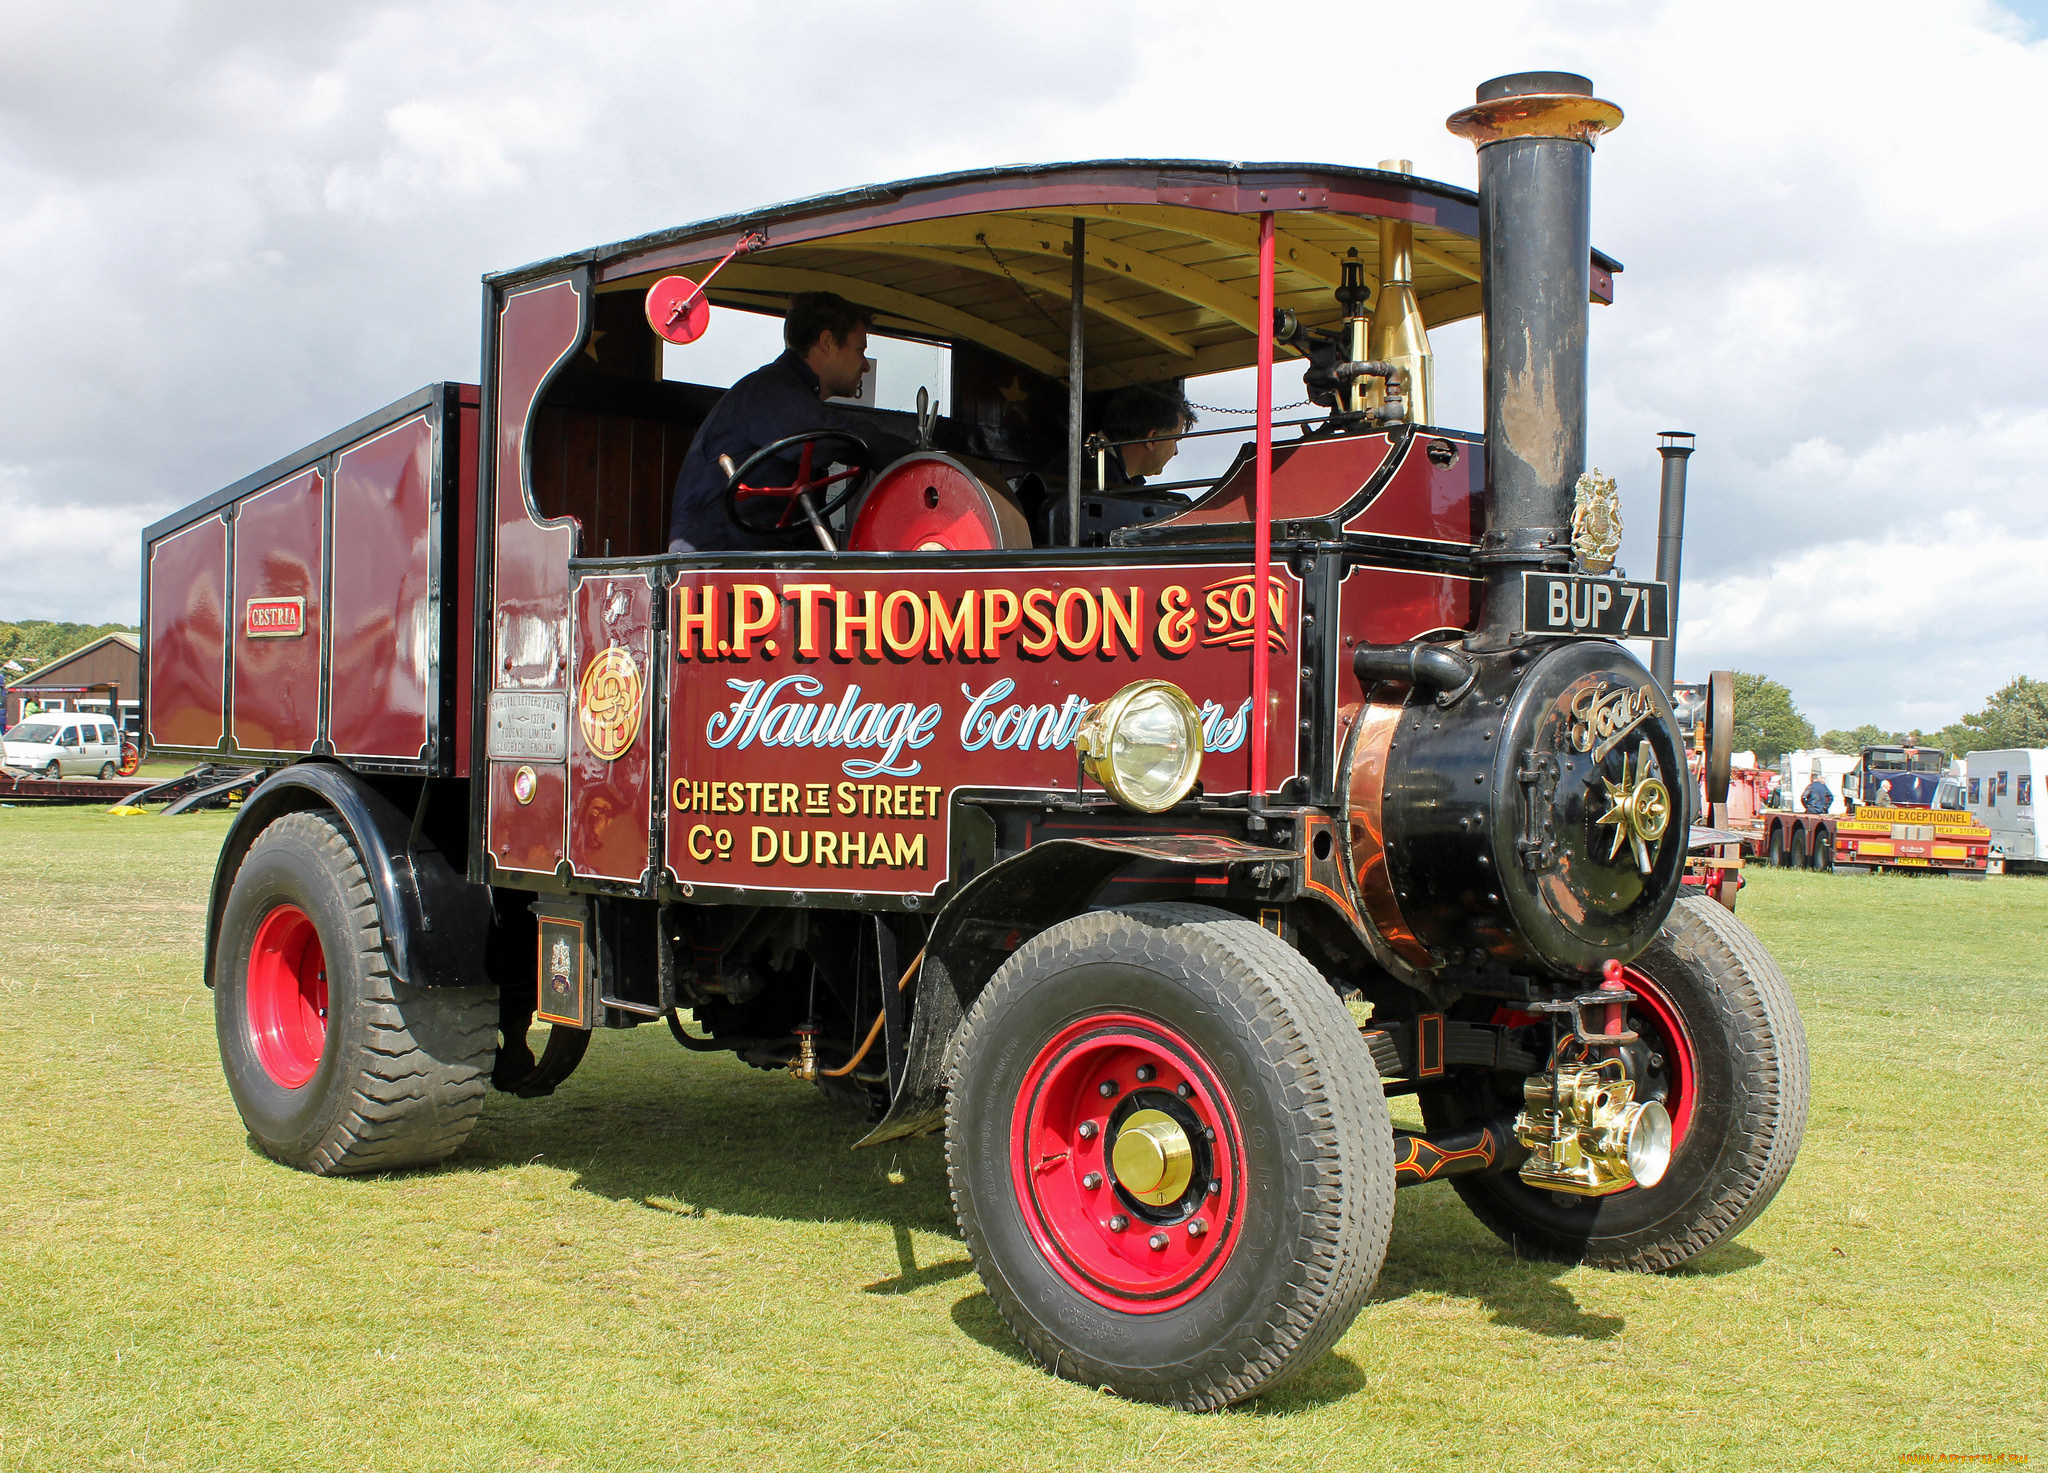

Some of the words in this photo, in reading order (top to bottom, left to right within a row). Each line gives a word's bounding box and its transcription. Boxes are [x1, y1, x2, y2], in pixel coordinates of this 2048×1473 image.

[252, 606, 296, 626] CESTRIA
[1548, 581, 1612, 629] BUP
[1620, 586, 1651, 632] 71
[679, 584, 781, 658] H.P.
[783, 583, 1144, 659] THOMPSON
[1157, 585, 1199, 655] &
[1205, 583, 1287, 634] SON
[518, 694, 541, 708] LETTERS
[542, 697, 564, 713] PATENT
[706, 674, 943, 779] Haulage
[1571, 681, 1663, 760] Foden
[501, 727, 523, 739] FODENS
[528, 728, 552, 740] LIMITED
[496, 741, 526, 753] SANDBACH
[530, 742, 557, 754] ENGLAND
[673, 777, 800, 815] CHESTER
[805, 783, 830, 814] LE
[836, 781, 942, 818] STREET
[1838, 821, 1855, 829] REAR
[1860, 823, 1890, 831] STEERING
[1860, 808, 1896, 820] CONVOI
[1897, 810, 1967, 824] EXCEPTIONNEL
[1937, 826, 1953, 834] REAR
[1959, 828, 1988, 836] STEERING
[750, 826, 925, 868] DURHAM
